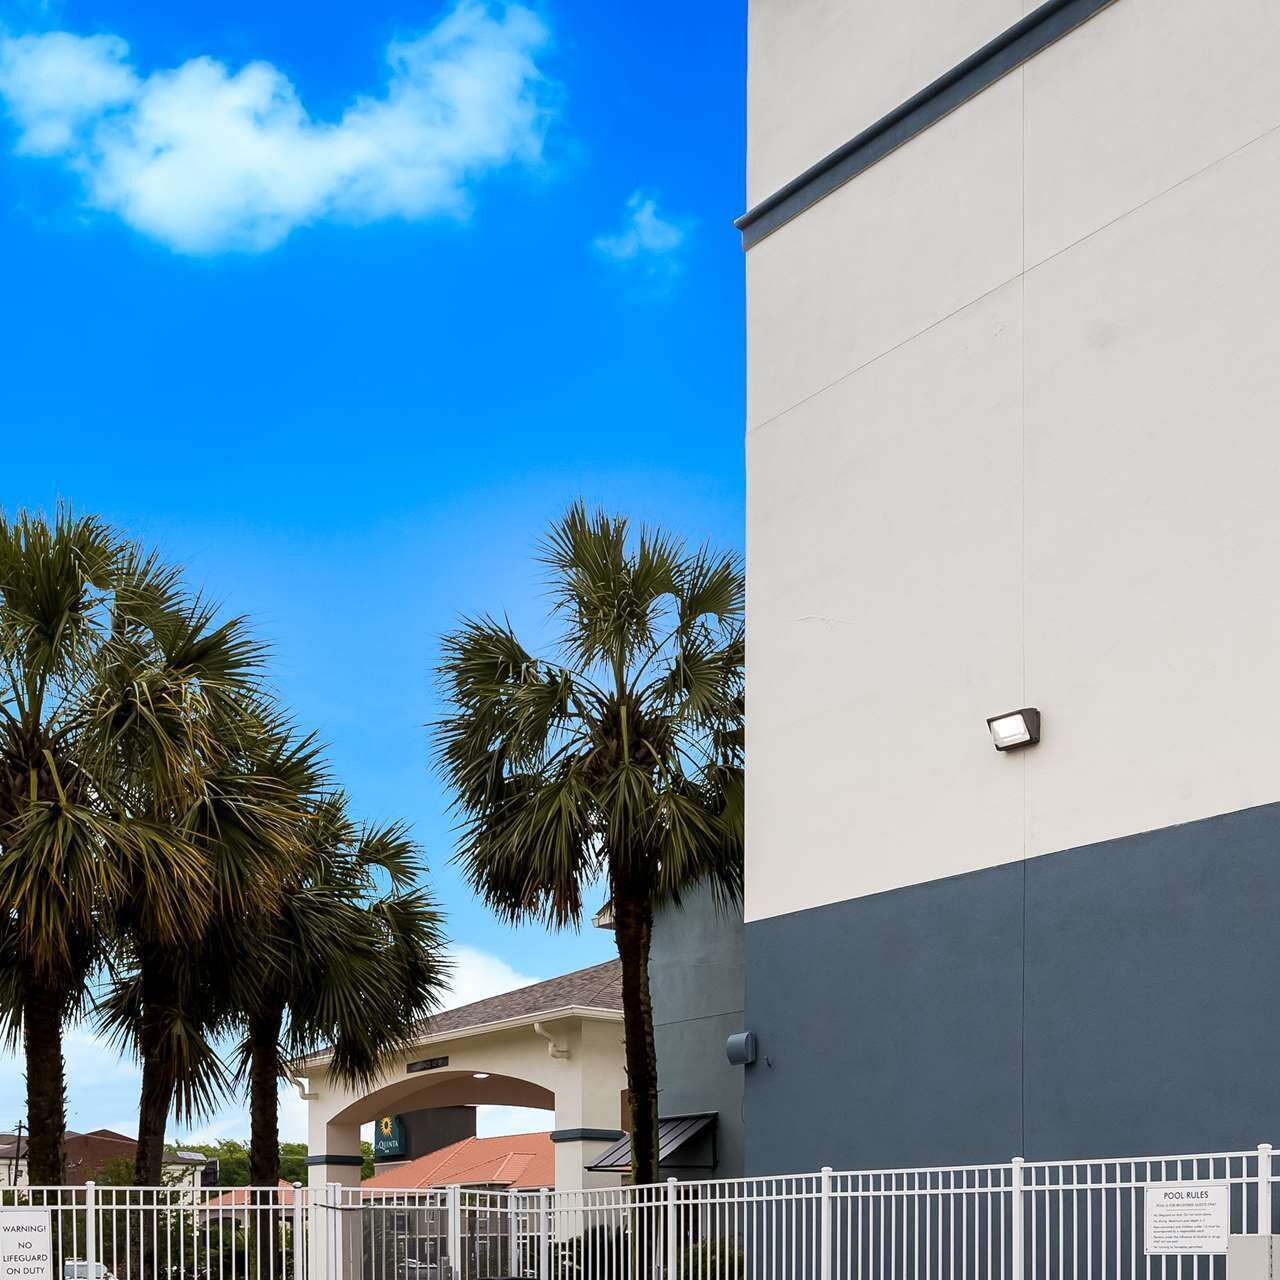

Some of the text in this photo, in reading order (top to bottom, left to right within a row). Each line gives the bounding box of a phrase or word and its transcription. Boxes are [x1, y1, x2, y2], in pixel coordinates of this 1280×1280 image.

[1164, 1190, 1209, 1200] POOL RULES
[2, 1225, 47, 1233] WARNING!
[18, 1241, 32, 1249] NO
[3, 1254, 48, 1263] LIFEGUARD
[6, 1266, 45, 1275] ON DUTY
